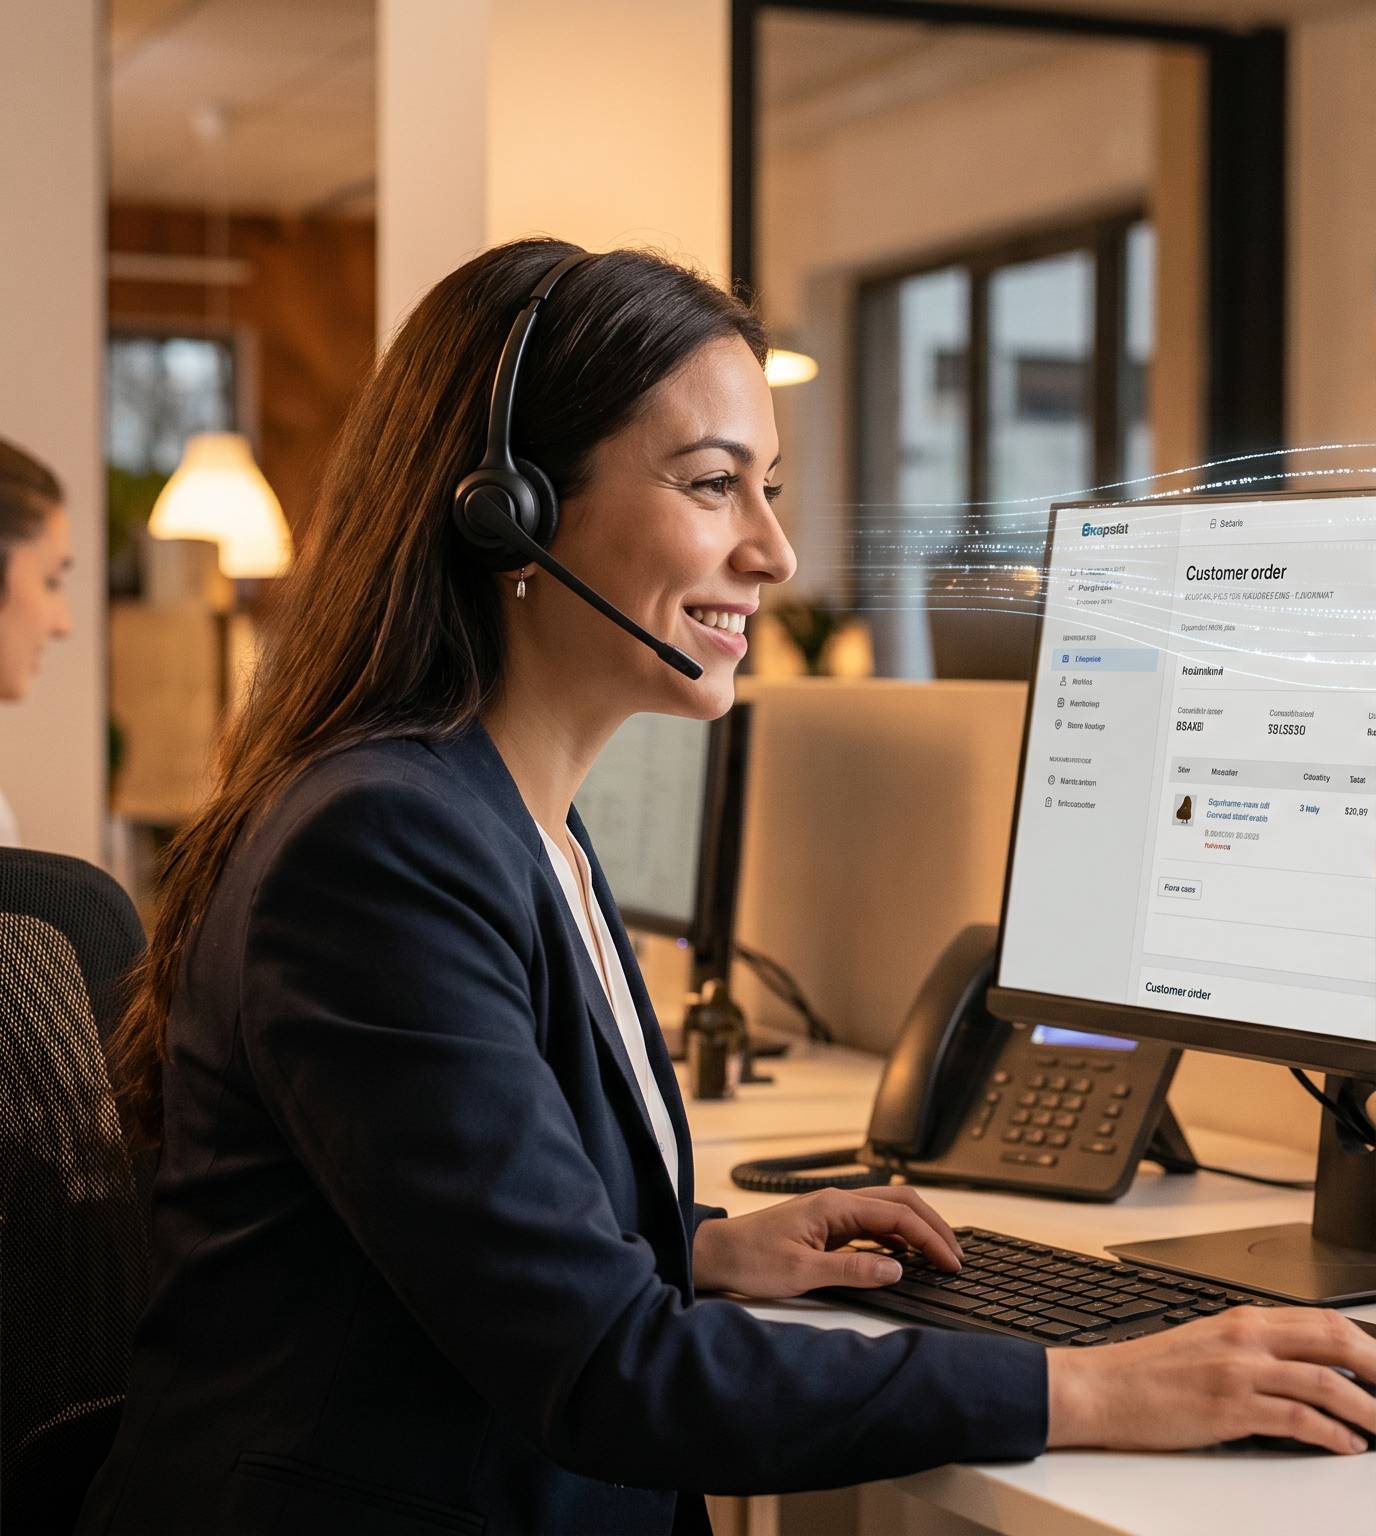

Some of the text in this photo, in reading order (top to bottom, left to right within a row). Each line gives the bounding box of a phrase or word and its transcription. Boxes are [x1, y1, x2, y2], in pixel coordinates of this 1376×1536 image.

[1186, 563, 1287, 581] Customer order
[1145, 981, 1212, 1001] Customer order
